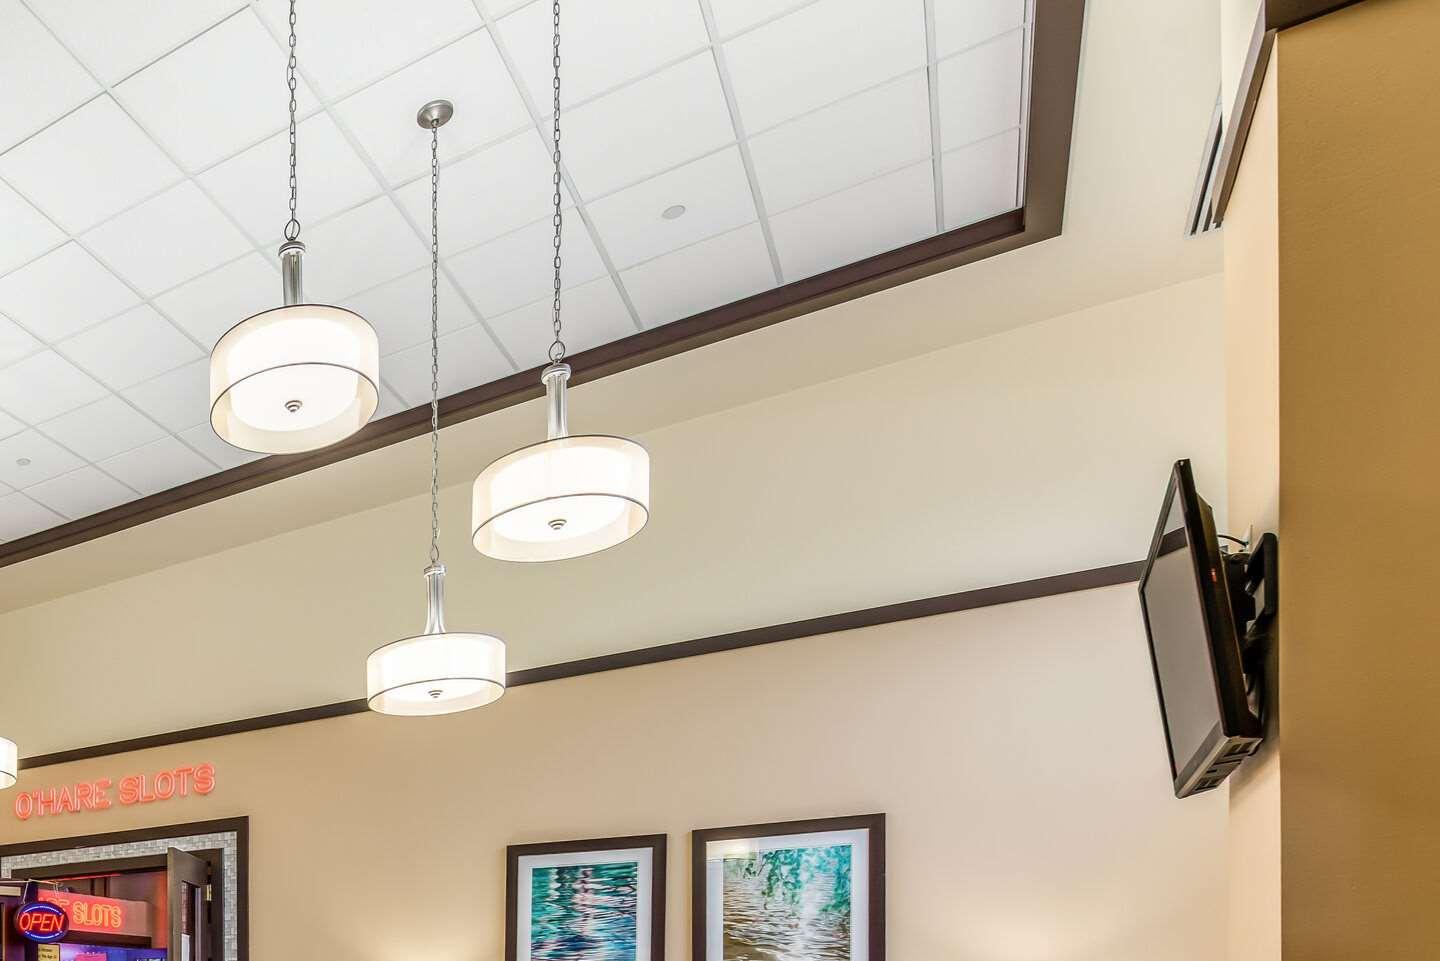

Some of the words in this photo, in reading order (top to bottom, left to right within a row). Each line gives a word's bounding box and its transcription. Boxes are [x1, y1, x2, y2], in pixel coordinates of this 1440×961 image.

[15, 777, 112, 820] O'HARE
[119, 763, 216, 804] SLOTS
[19, 912, 66, 932] OPEN
[72, 901, 122, 928] SLOTS
